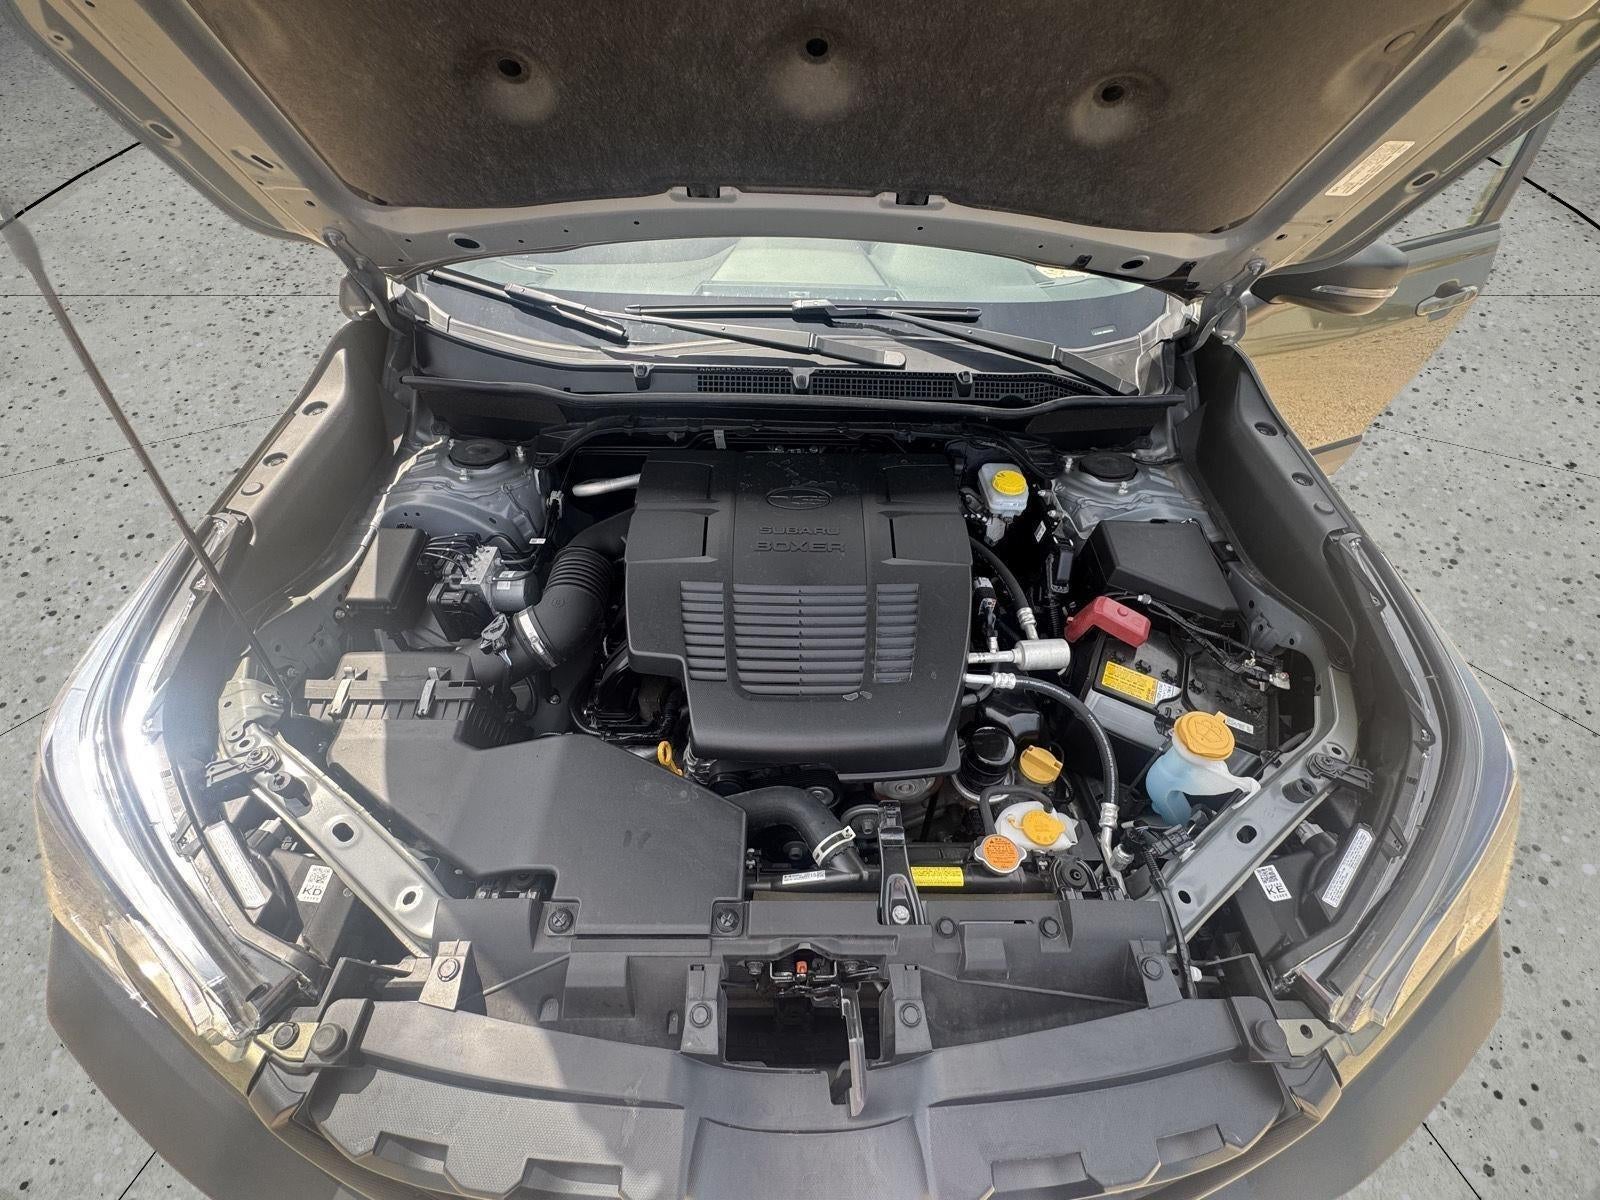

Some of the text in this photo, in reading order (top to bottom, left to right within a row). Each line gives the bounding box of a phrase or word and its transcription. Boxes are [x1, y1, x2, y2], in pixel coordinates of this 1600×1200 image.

[759, 526, 840, 536] SUBARU
[754, 541, 846, 553] BOXER
[302, 887, 322, 895] KD
[1266, 885, 1285, 895] KE
